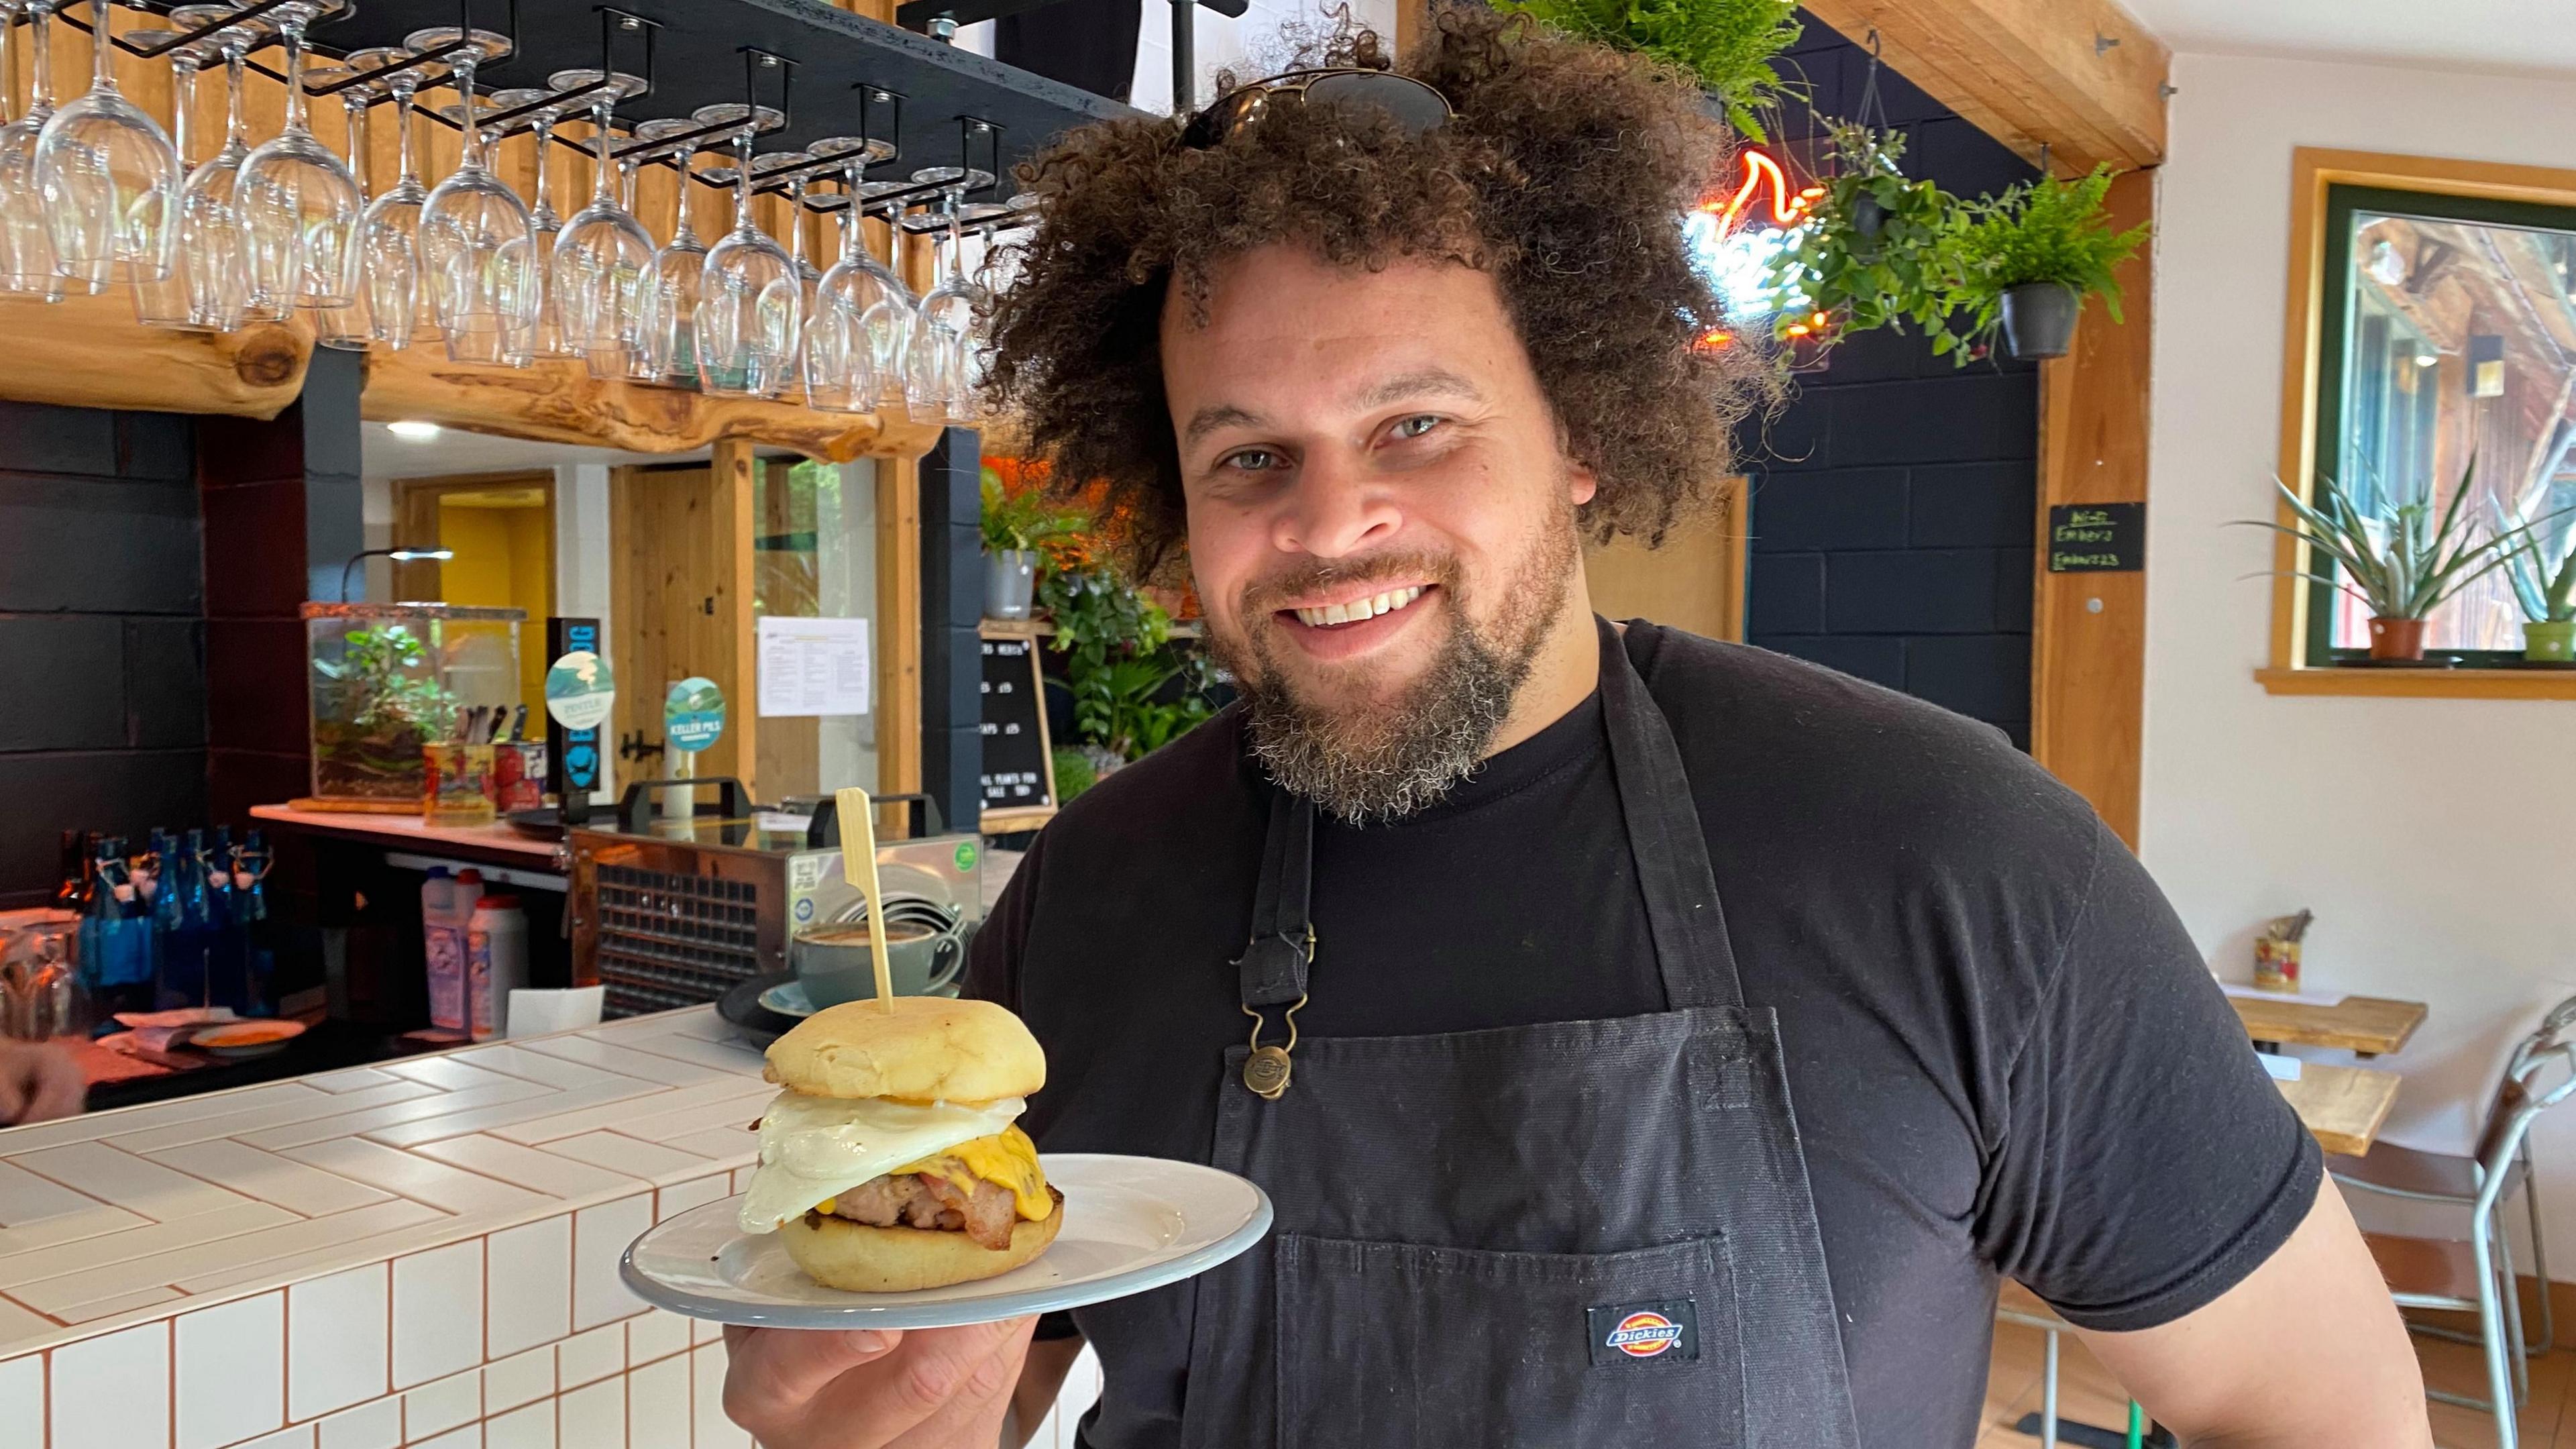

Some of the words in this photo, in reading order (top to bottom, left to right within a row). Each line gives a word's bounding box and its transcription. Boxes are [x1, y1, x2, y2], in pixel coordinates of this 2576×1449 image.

[670, 722, 701, 736] KELLER
[703, 720, 721, 733] PILS
[994, 773, 1020, 786] PLANTS
[987, 786, 1006, 798] SALE
[1614, 1328, 1674, 1342] Dickies
